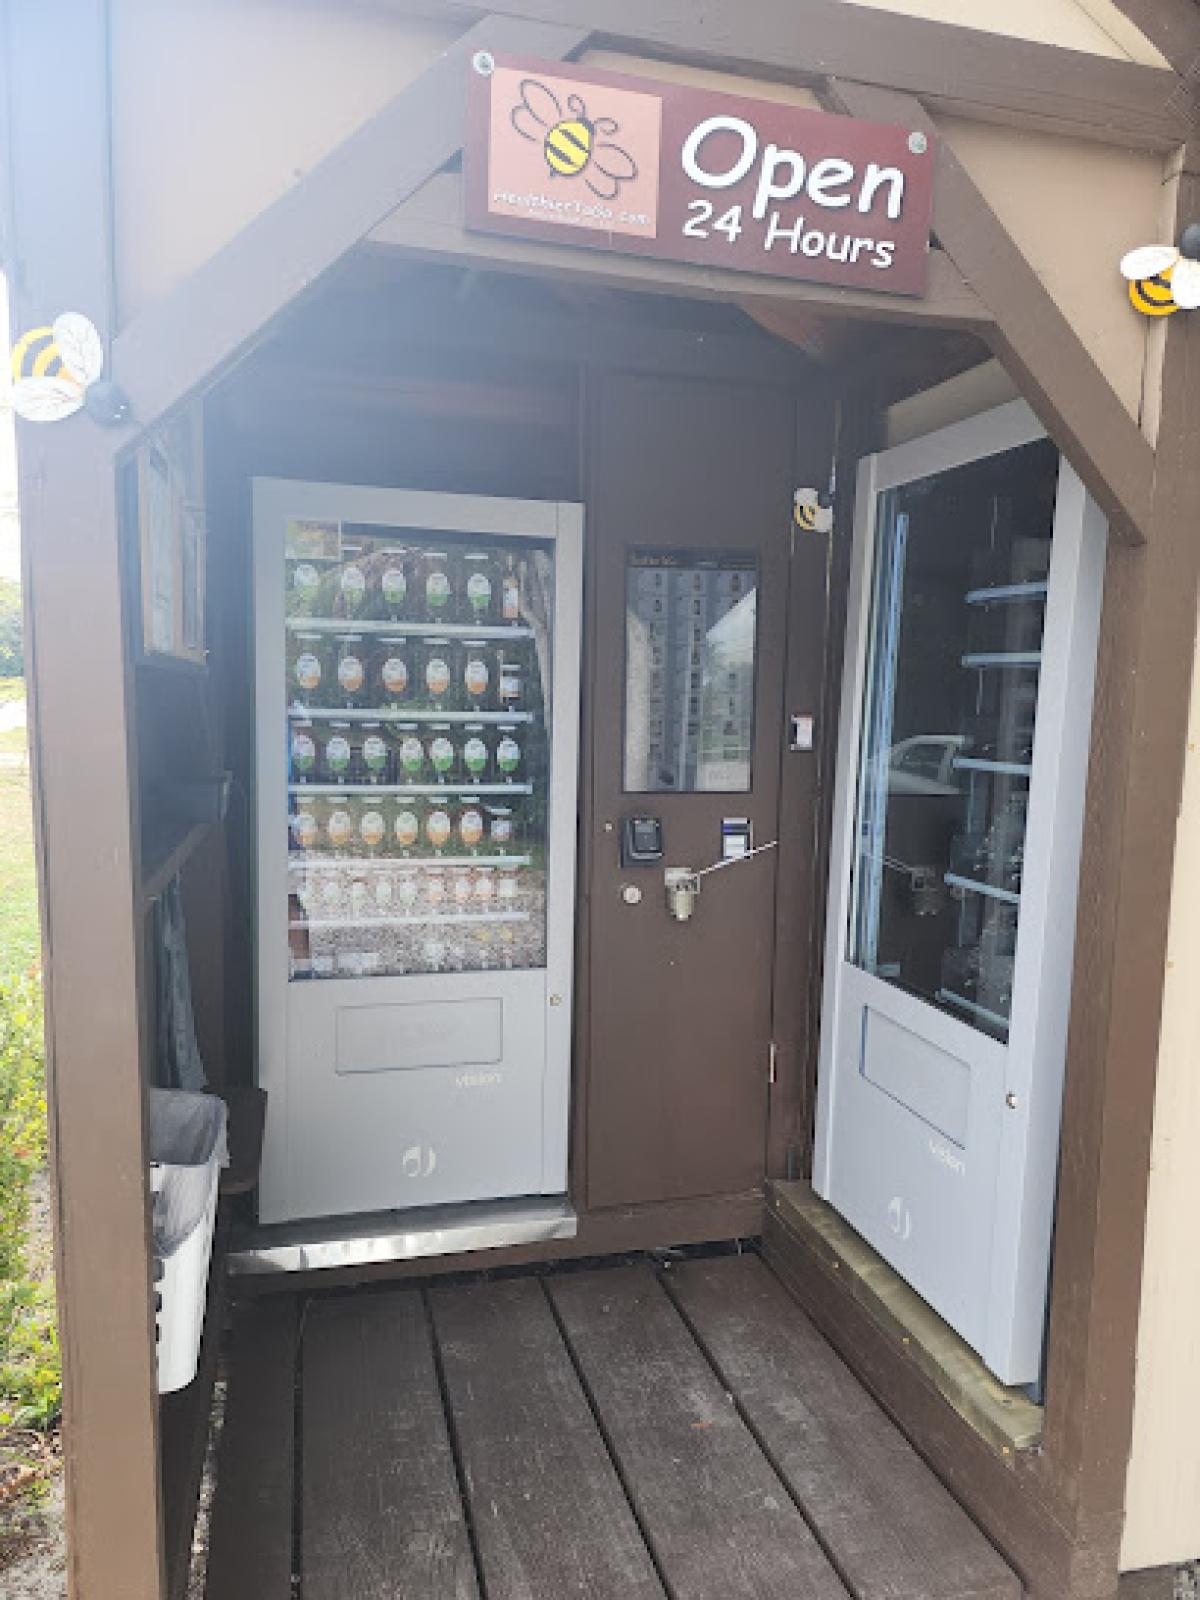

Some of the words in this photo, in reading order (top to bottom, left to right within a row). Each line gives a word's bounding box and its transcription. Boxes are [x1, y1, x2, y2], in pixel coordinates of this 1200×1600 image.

[681, 115, 904, 219] Open
[682, 199, 742, 243] 24
[764, 211, 896, 269] Hours
